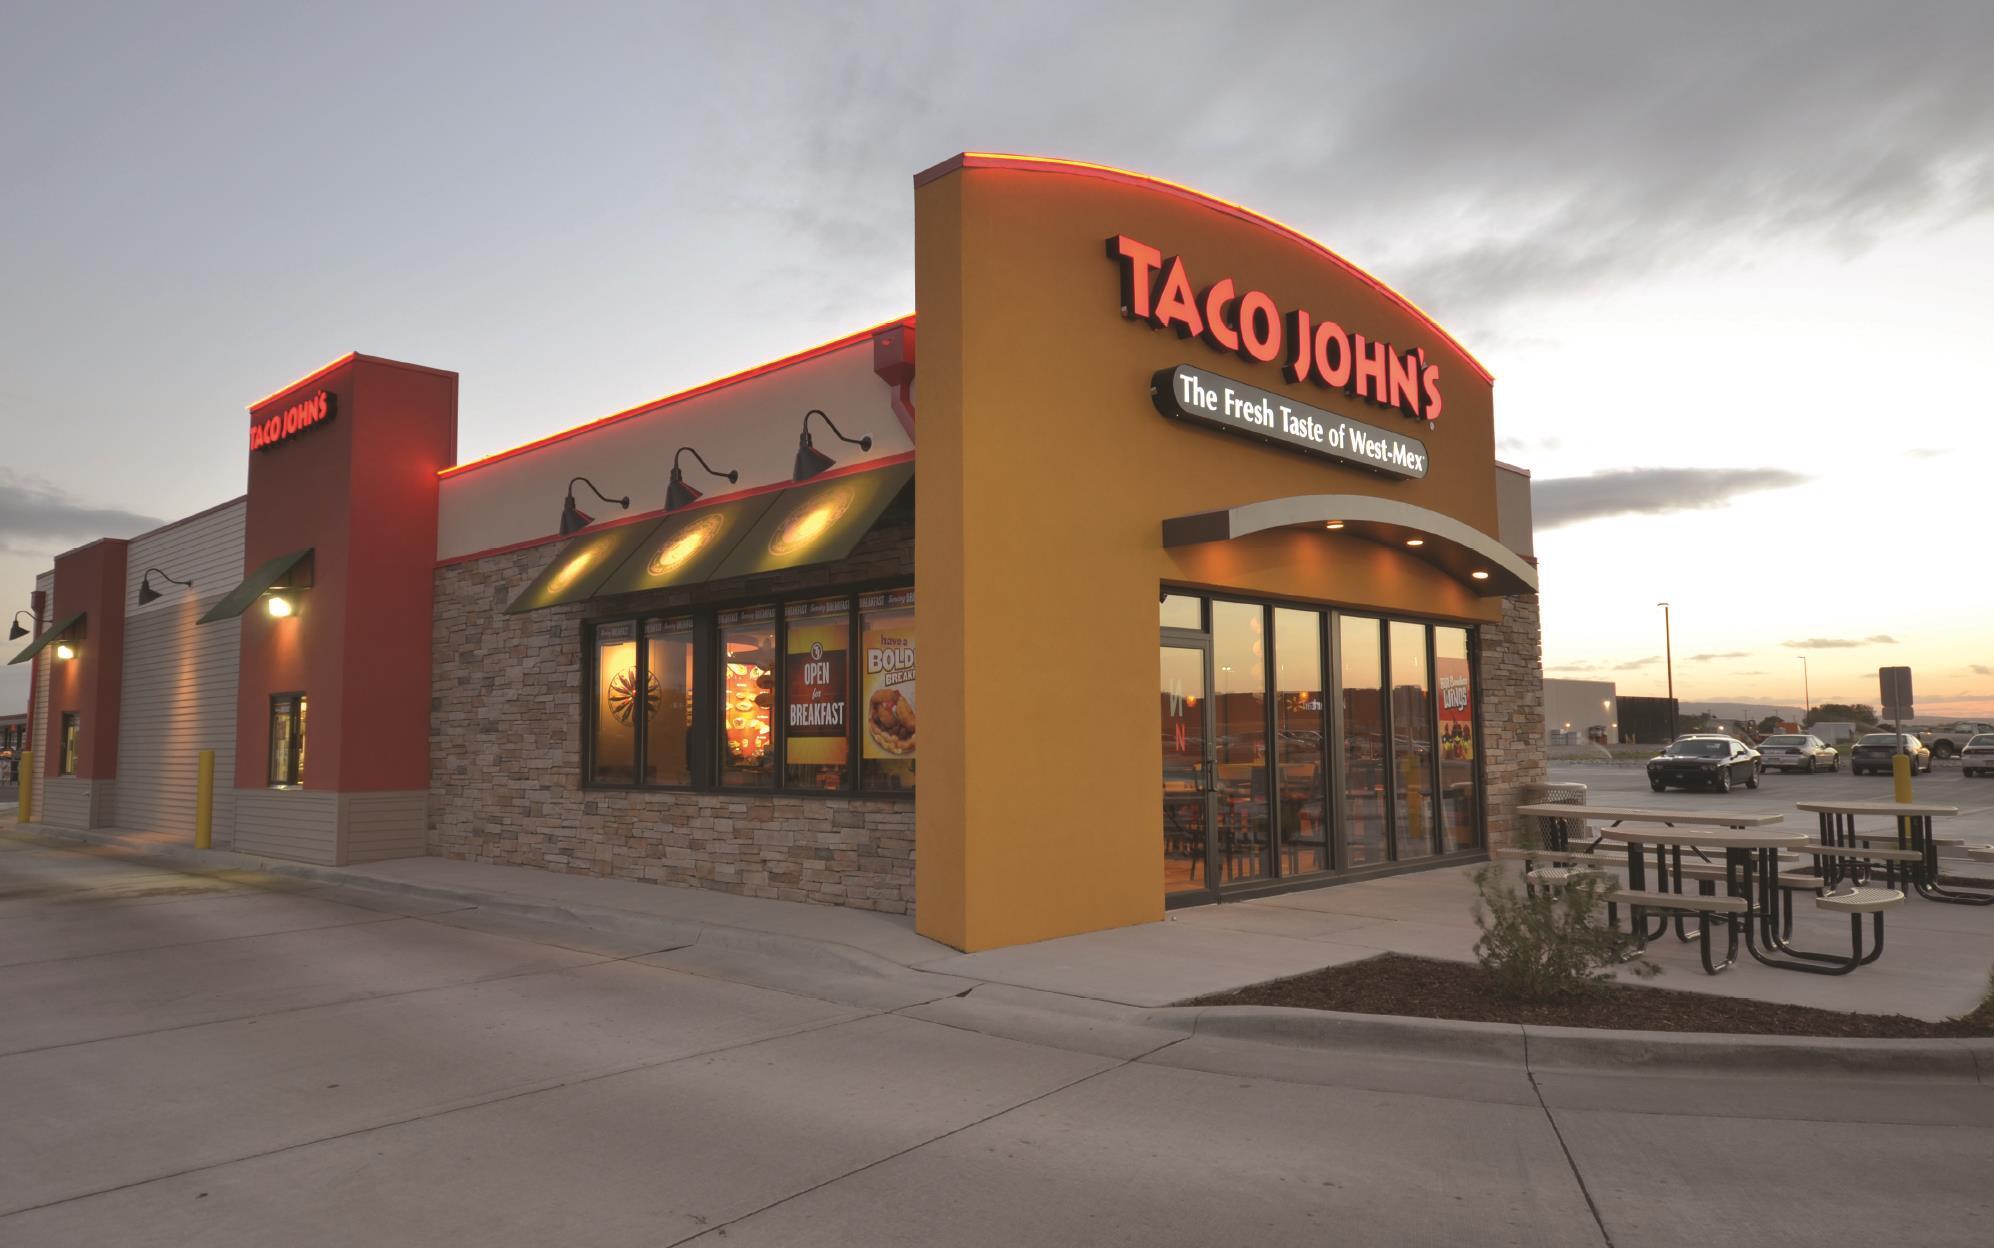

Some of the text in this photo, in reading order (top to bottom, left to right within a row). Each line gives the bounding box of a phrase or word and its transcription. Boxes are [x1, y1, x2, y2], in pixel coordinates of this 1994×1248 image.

[1119, 234, 1443, 420] TACO JOHN'S
[250, 389, 328, 450] TACO JOHN'S
[1179, 374, 1423, 471] The Fresh Taste of West-Mex
[804, 662, 830, 685] OPEN
[867, 648, 915, 674] BOLD
[885, 669, 915, 687] BREAK
[812, 687, 822, 700] for
[790, 702, 845, 726] BREAKFAST
